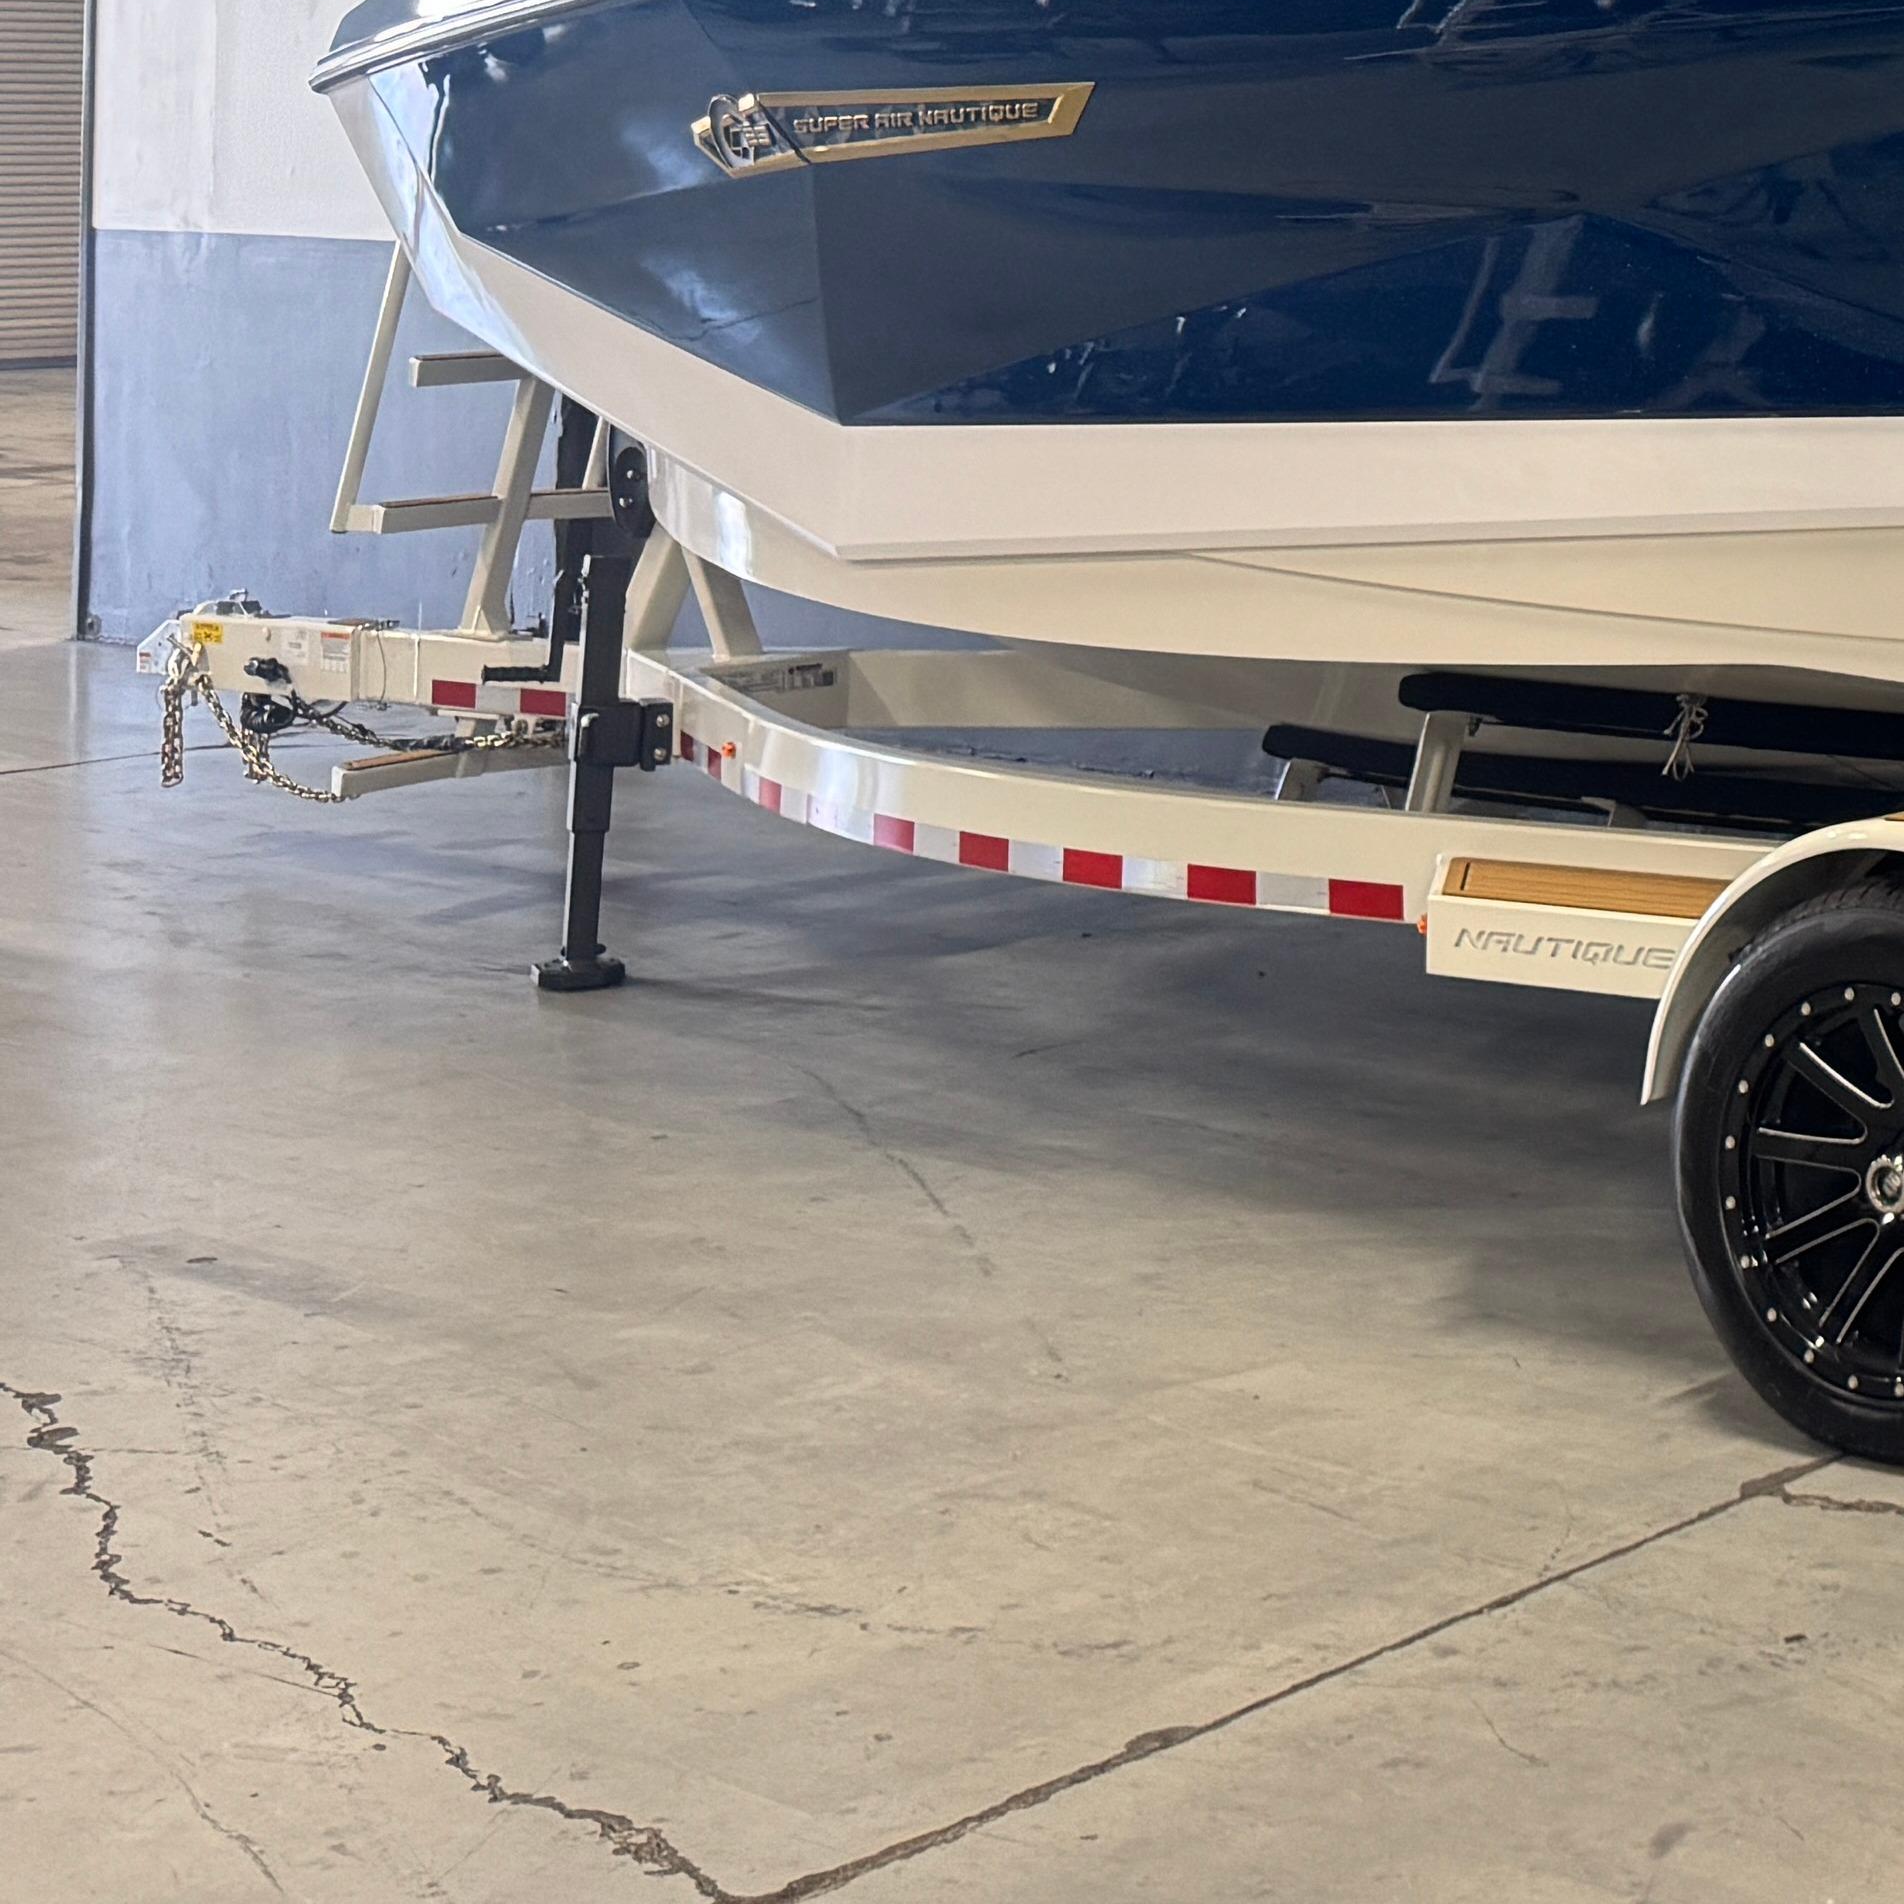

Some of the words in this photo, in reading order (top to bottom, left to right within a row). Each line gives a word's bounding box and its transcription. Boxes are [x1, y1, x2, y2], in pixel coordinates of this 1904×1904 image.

[793, 114, 870, 134] SUPER
[874, 111, 914, 129] AIR
[918, 102, 1039, 126] NAUTIQUE
[1454, 927, 1677, 970] NAUTIQUE
